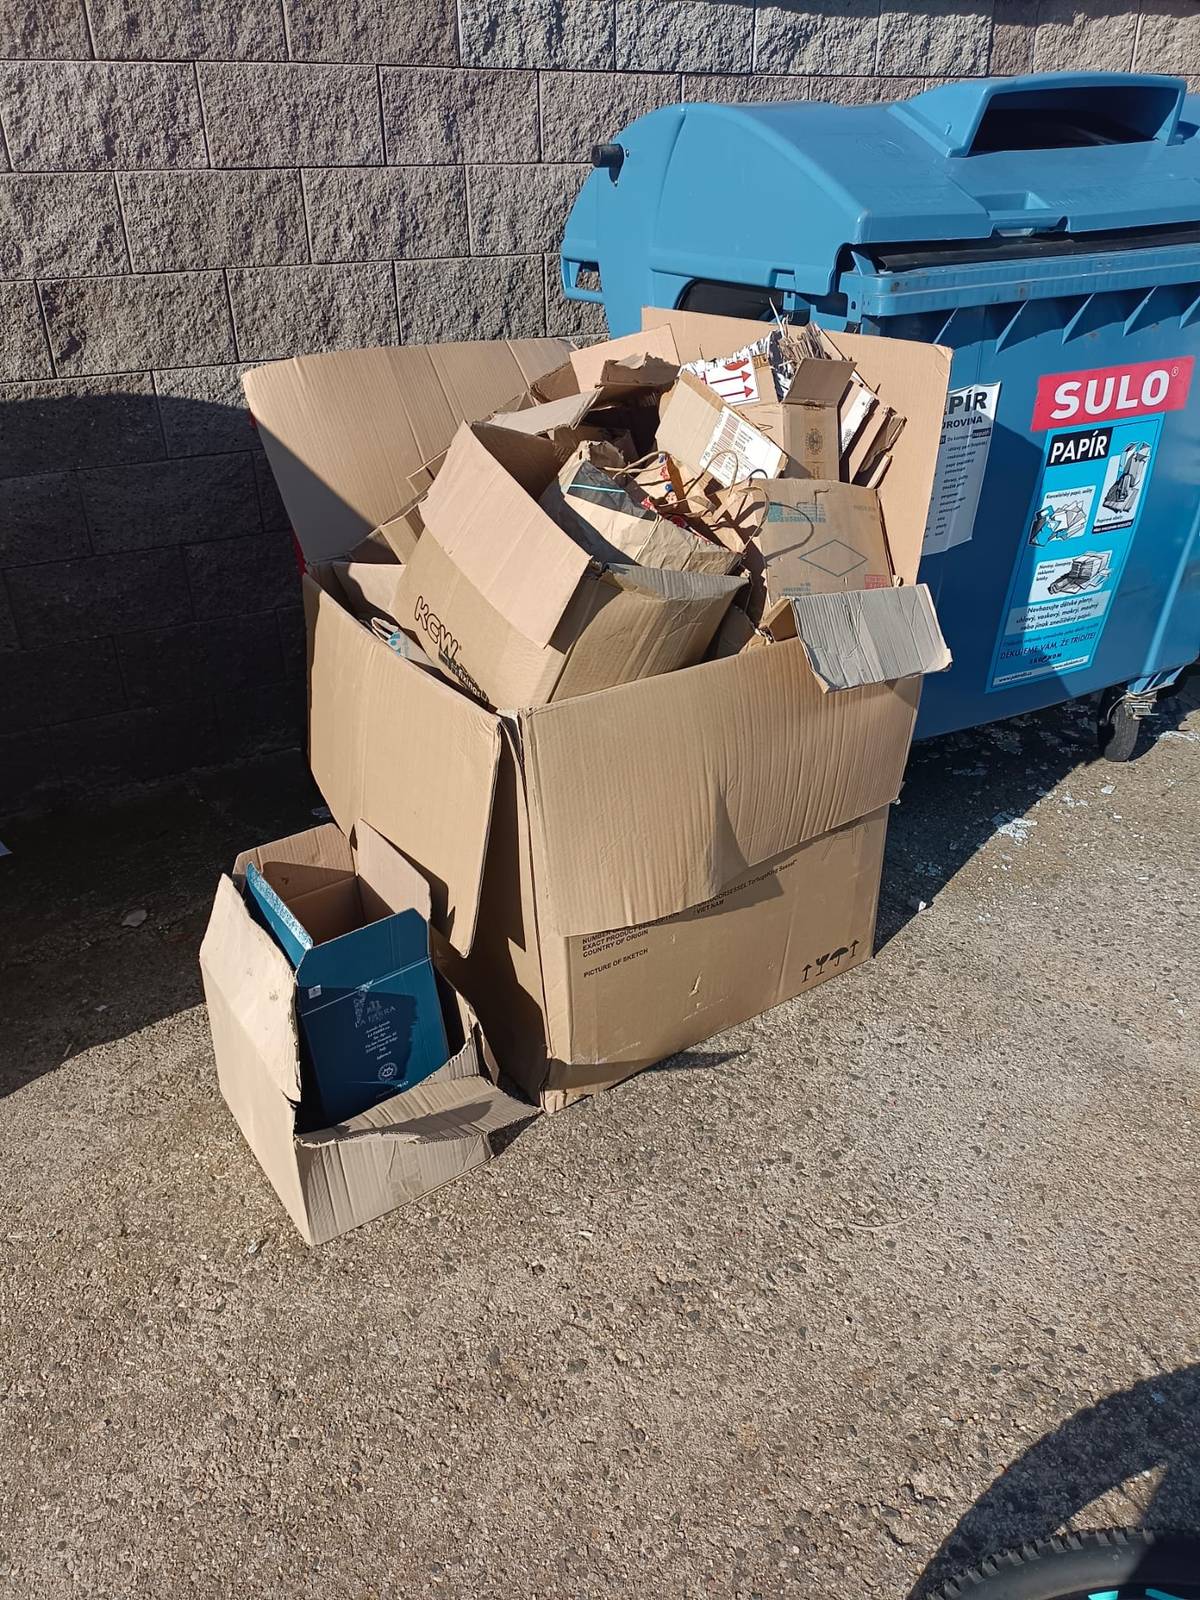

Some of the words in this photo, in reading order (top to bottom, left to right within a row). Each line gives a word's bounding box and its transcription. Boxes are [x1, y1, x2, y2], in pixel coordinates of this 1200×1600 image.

[944, 390, 988, 416] PÍR
[1050, 369, 1170, 420] SULO
[1050, 430, 1108, 464] PAPÍR
[582, 938, 605, 952] EXACT
[605, 928, 637, 943] PRODUCT
[583, 941, 615, 958] COUNTRY
[616, 937, 625, 946] OF
[626, 928, 649, 943] ORIGIN
[583, 962, 612, 978] PICTURE
[612, 957, 622, 967] OF
[622, 947, 649, 963] SKETCH
